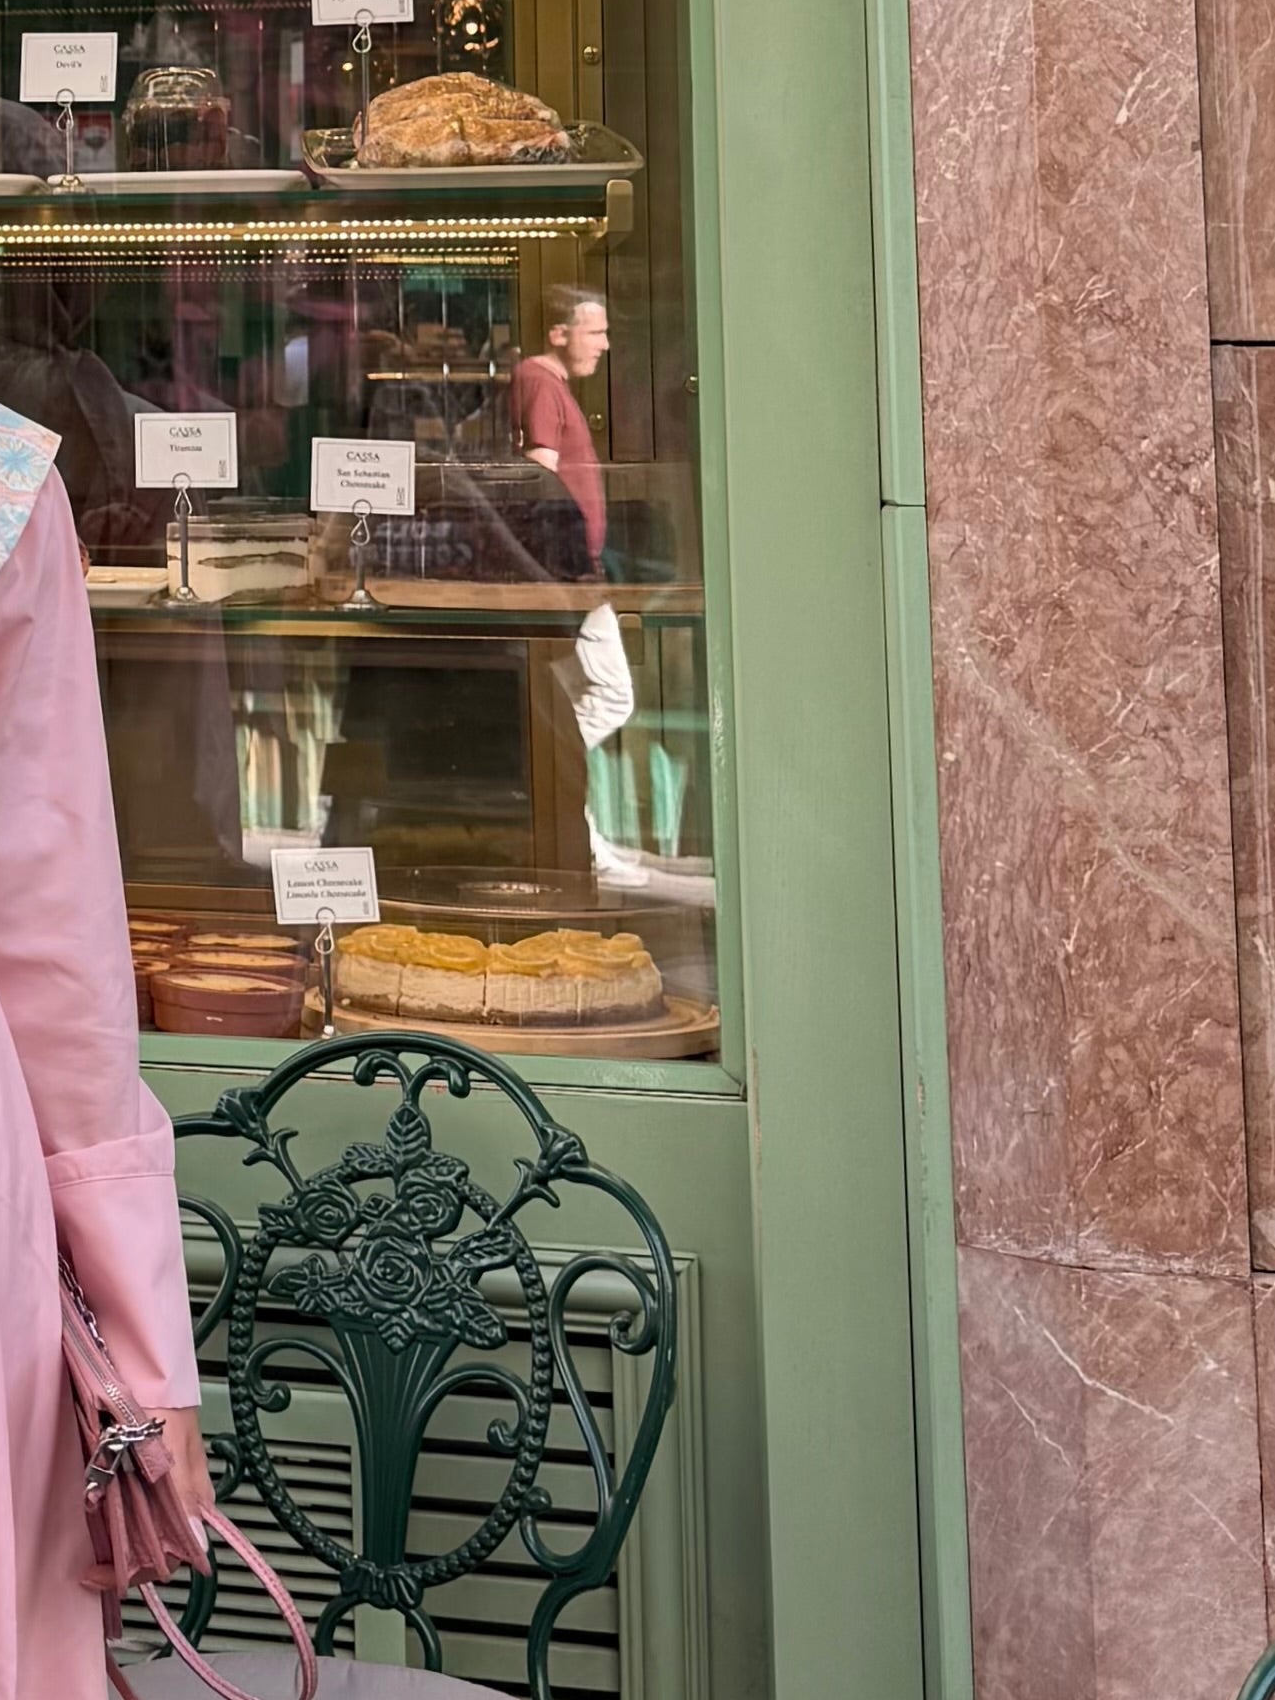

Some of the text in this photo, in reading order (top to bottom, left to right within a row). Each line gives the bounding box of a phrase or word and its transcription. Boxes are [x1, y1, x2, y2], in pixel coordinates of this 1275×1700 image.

[53, 44, 86, 55] CASSA
[346, 451, 380, 462] CASSA
[304, 860, 339, 871] CASSA
